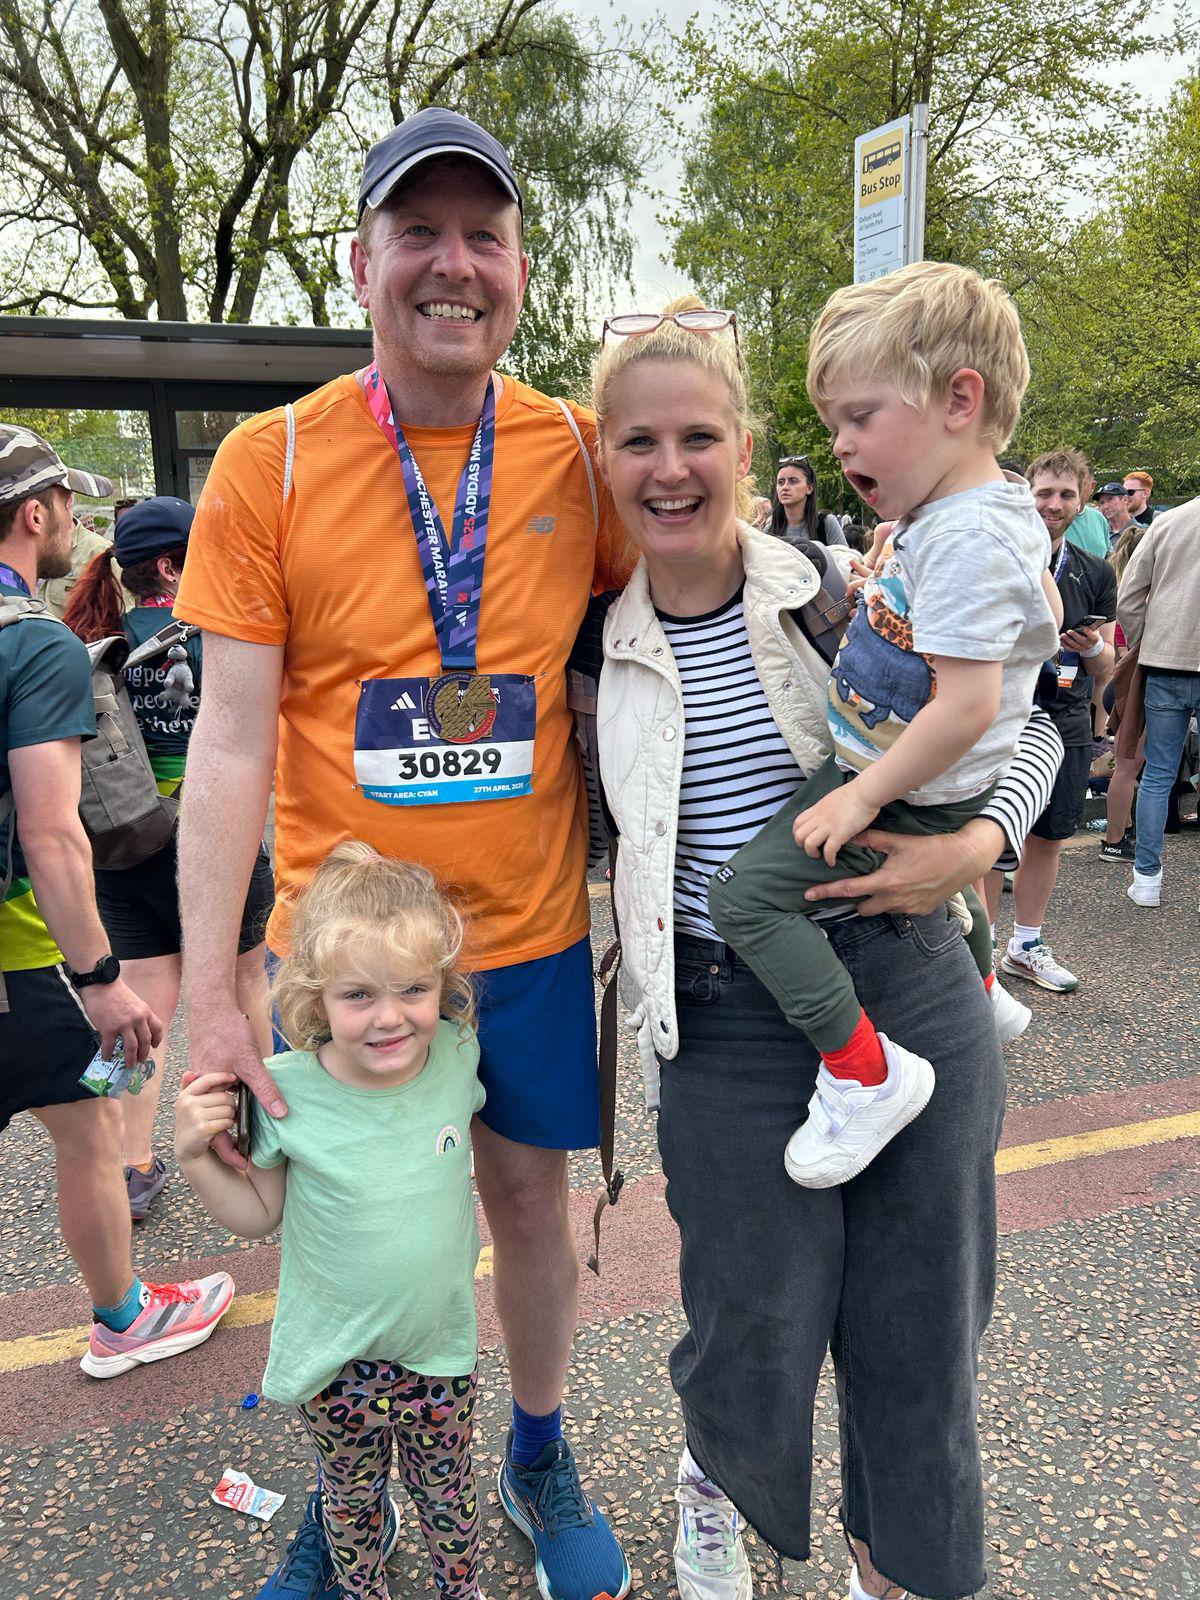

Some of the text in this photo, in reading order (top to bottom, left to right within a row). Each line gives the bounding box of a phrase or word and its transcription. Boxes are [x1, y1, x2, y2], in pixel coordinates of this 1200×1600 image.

[861, 173, 901, 197] Bus Stop
[465, 463, 480, 516] ADIDAS
[461, 517, 475, 550] 2025
[398, 747, 502, 780] 30829
[392, 791, 416, 799] AREA:
[417, 789, 439, 798] CYAN
[473, 785, 492, 793] 27TH
[492, 783, 511, 792] APRIL
[1104, 846, 1122, 855] HOKA
